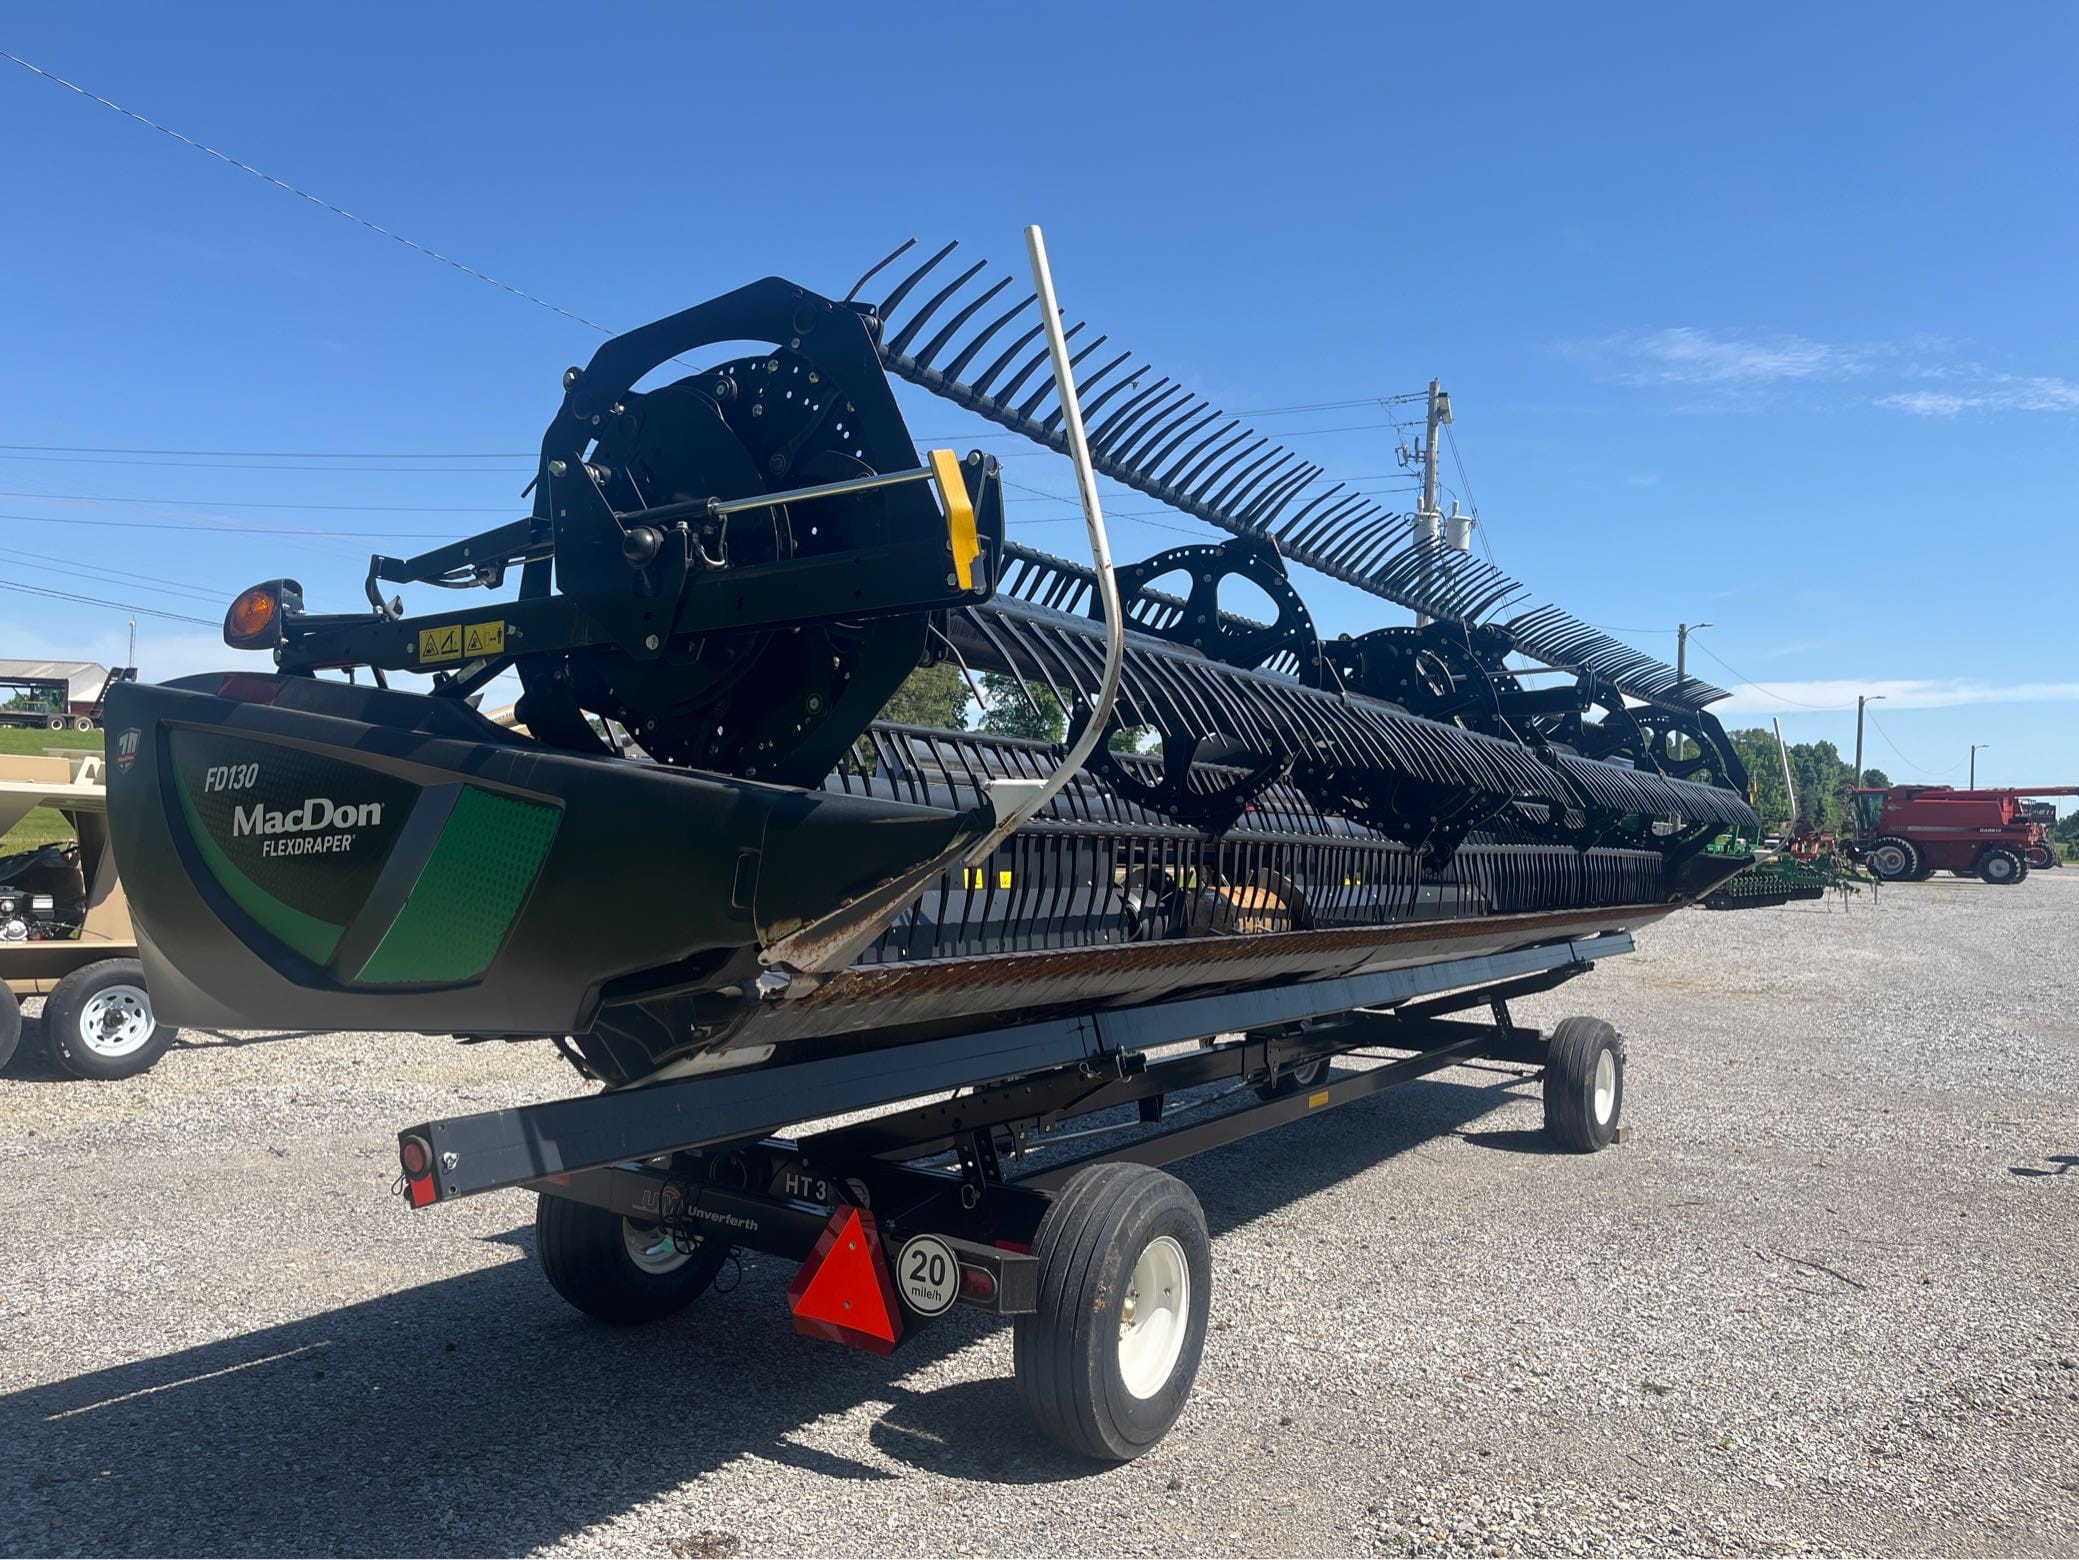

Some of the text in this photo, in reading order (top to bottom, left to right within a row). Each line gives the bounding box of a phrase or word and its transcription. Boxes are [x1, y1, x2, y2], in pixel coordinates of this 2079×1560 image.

[204, 763, 260, 793] FD130
[232, 798, 382, 837] MacDon
[262, 834, 353, 858] FLEXDRAPER
[785, 1172, 813, 1198] HT
[687, 1204, 759, 1231] Unverferth
[909, 1249, 946, 1287] 20
[911, 1285, 942, 1302] mile/h
